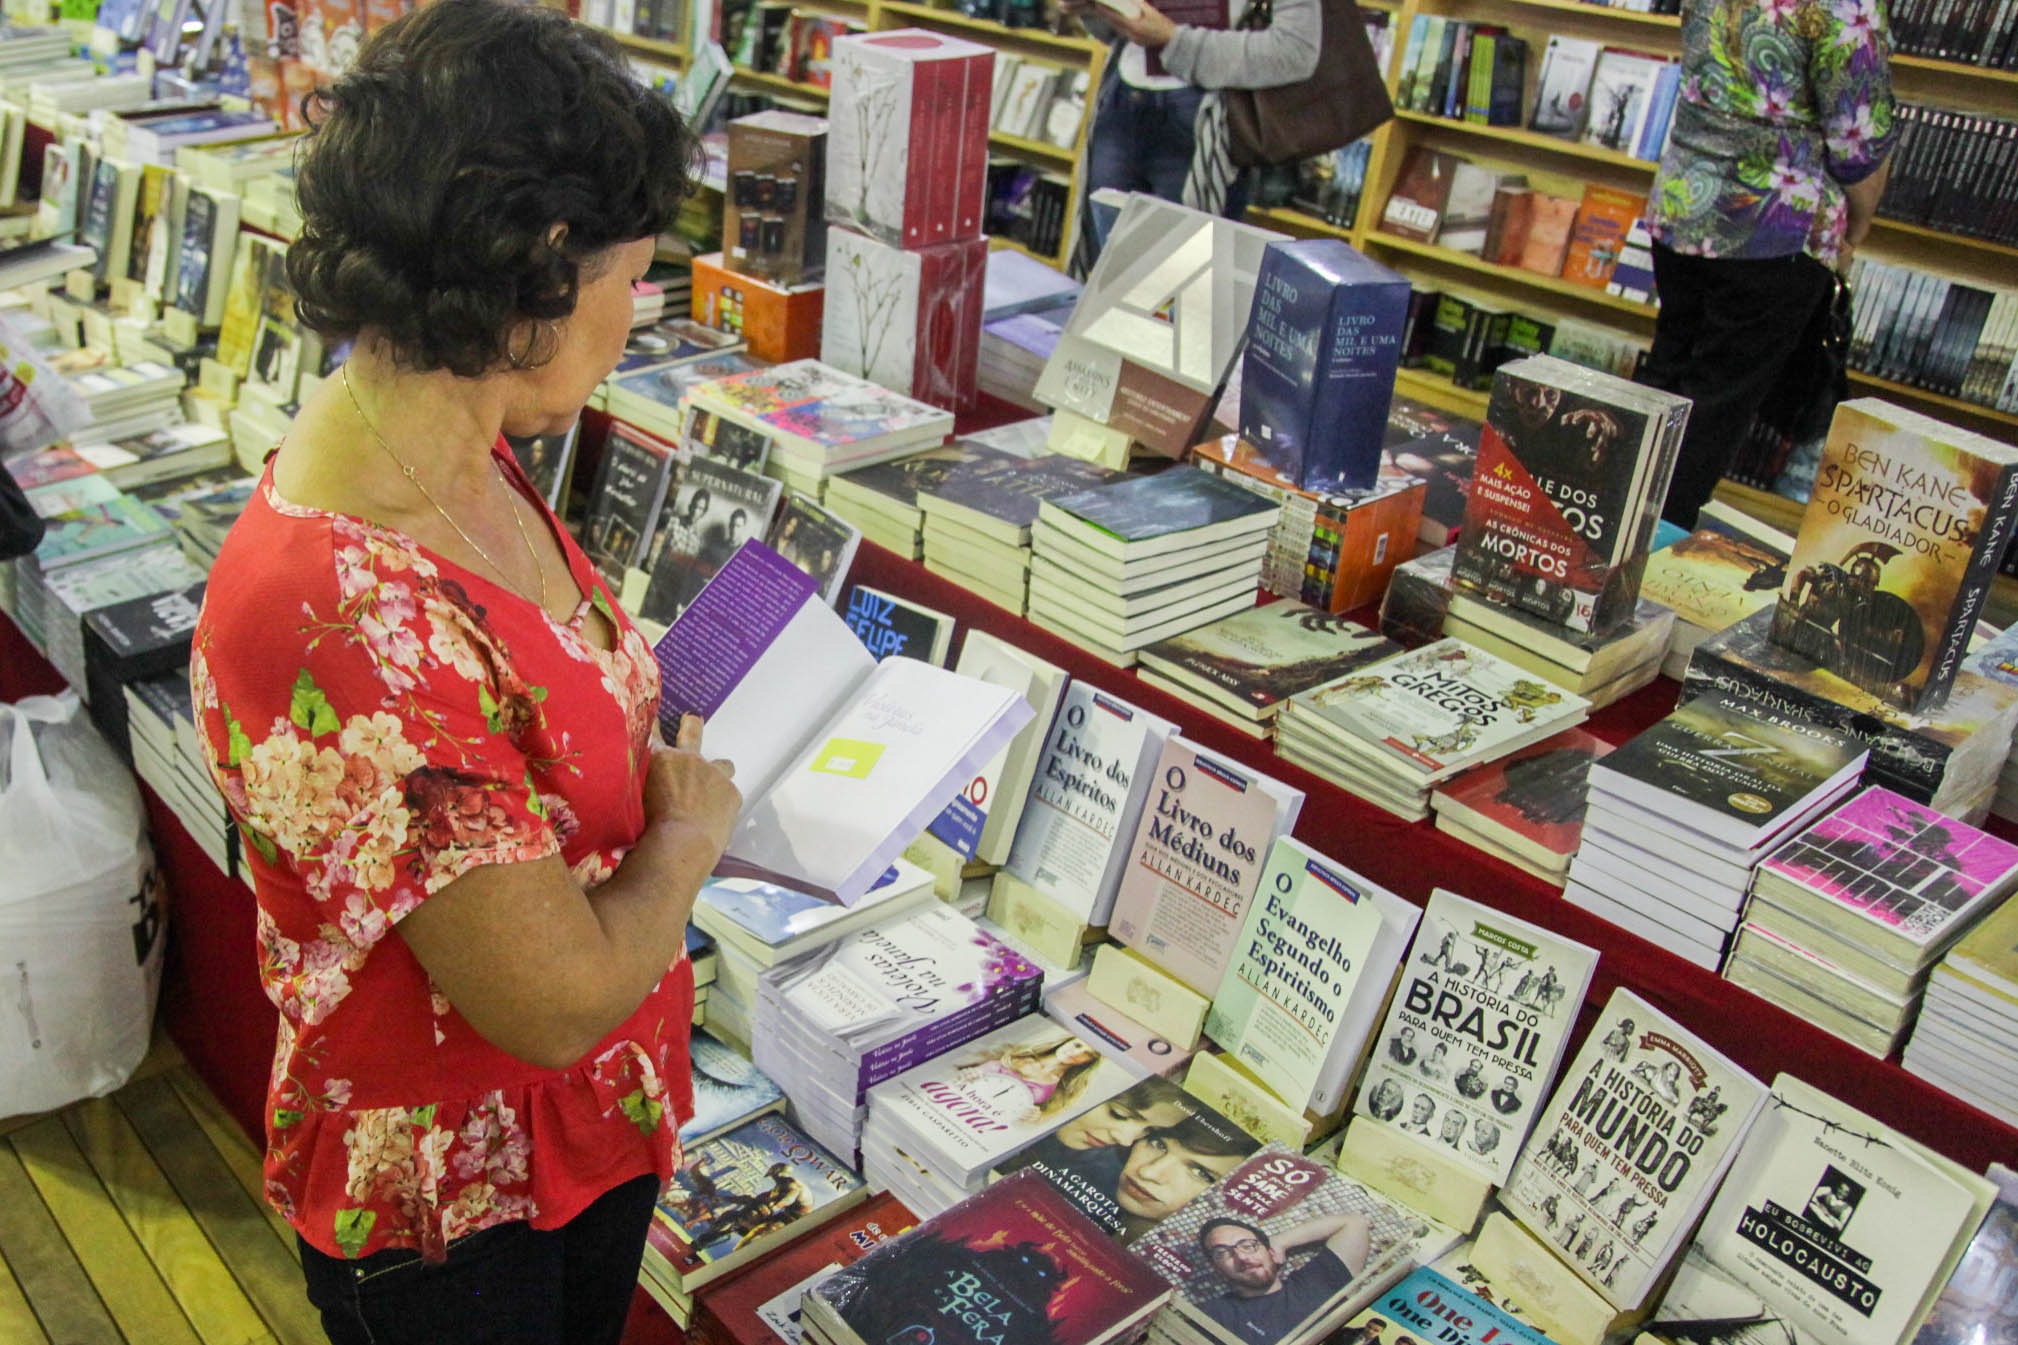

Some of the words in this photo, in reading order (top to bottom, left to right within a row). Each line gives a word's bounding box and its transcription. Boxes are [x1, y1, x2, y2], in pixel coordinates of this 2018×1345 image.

[1261, 290, 1282, 314] DAS
[1265, 272, 1298, 303] LIVRO
[1258, 307, 1277, 331] MIL
[1279, 321, 1288, 336] E
[1288, 330, 1316, 358] UMA
[1335, 337, 1356, 346] MIL
[1360, 337, 1368, 345] E
[1370, 335, 1396, 344] UMA
[1337, 327, 1359, 336] DAS
[1339, 315, 1375, 326] LIVRO
[1254, 324, 1292, 362] NOITES
[1332, 346, 1376, 357] NOITES
[691, 469, 764, 504] SUPERNATURAL
[1480, 474, 1502, 489] MAIS
[1504, 483, 1531, 500] AÇÃO
[1494, 462, 1513, 481] 4x
[1844, 442, 1893, 478] BEN
[1896, 463, 1968, 508] KANE
[2003, 472, 2018, 509] BEN
[1477, 486, 1482, 496] E
[1484, 489, 1531, 513] SUSPENSE!
[1560, 485, 1597, 509] DOS
[1820, 464, 1970, 543] SPARTACUS
[1486, 519, 1498, 530] AS
[1500, 521, 1549, 549] CRÔNICAS
[1550, 542, 1571, 557] DOS
[1827, 499, 1841, 516] O
[1843, 505, 1941, 563] GLADIADOR
[1979, 516, 2007, 567] KANE
[1481, 533, 1568, 578] MORTOS
[850, 585, 896, 627] LUIZ
[1937, 587, 1981, 681] SPARTACUS
[1391, 673, 1498, 727] GREGOS
[1423, 671, 1502, 712] MITOS
[1067, 705, 1085, 729] O
[1670, 723, 1735, 750] GUERRA
[1719, 698, 1763, 718] MAX
[1768, 714, 1847, 748] BROOKS
[1056, 728, 1102, 770] Livro
[1106, 759, 1130, 788] dos
[1655, 740, 1679, 752] UMA
[1046, 755, 1117, 814] Espíritos
[1166, 766, 1186, 791] O
[1036, 784, 1072, 811] ALLAN
[1075, 808, 1115, 838] KARDEC
[1157, 789, 1213, 838] Livro
[1219, 827, 1256, 864] dos
[1149, 815, 1240, 885] Médiuns
[1142, 851, 1182, 881] ALLAN
[1186, 878, 1241, 915] KARDEC
[1276, 872, 1293, 894] O
[1265, 894, 1351, 973] Evangelho
[1478, 927, 1507, 945] MARCOS
[1507, 940, 1530, 955] COSTA
[1256, 918, 1330, 984] Segundo
[1333, 983, 1342, 997] o
[864, 952, 941, 1014] Violetas
[1248, 940, 1335, 1023] Espiritismo
[1427, 971, 1439, 984] A
[1445, 978, 1510, 1017] HISTÓRIA
[1515, 1009, 1539, 1028] DO
[1238, 963, 1281, 1000] ALLAN
[1284, 998, 1329, 1046] KARDEC
[1404, 978, 1541, 1068] BRASIL
[1147, 1038, 1172, 1055] O
[1398, 1011, 1427, 1031] PARA
[1430, 1026, 1463, 1047] QUEM
[1466, 1042, 1489, 1060] TEM
[1491, 1054, 1533, 1081] PRESSA
[1649, 1034, 1672, 1050] EMMA
[920, 1081, 1008, 1134] agora!
[966, 1089, 992, 1110] hora
[1173, 1100, 1197, 1117] David
[1195, 1114, 1233, 1143] Ebershoff
[1589, 1058, 1604, 1079] A
[1603, 1067, 1677, 1136] HISTÓRIA
[1676, 1126, 1705, 1156] DO
[1568, 1075, 1691, 1193] MUNDO
[1264, 1159, 1317, 1185] SÓ
[1560, 1111, 1583, 1139] PARA
[1583, 1132, 1611, 1160] QUEM
[1610, 1153, 1631, 1178] TEM
[1629, 1171, 1669, 1209] PRESSA
[1031, 1160, 1128, 1236] DINAMARQUESA
[1057, 1167, 1069, 1175] A
[1070, 1173, 1120, 1214] GAROTA
[1226, 1188, 1270, 1215] SENTE
[1243, 1173, 1289, 1201] SABE
[1765, 1203, 1779, 1217] EU
[1784, 1214, 1848, 1258] SOBREVIVI
[1855, 1256, 1870, 1270] AO
[1741, 1216, 1875, 1307] HOLOCAUSTO
[1388, 1298, 1433, 1329] One
[1417, 1290, 1474, 1331] One
